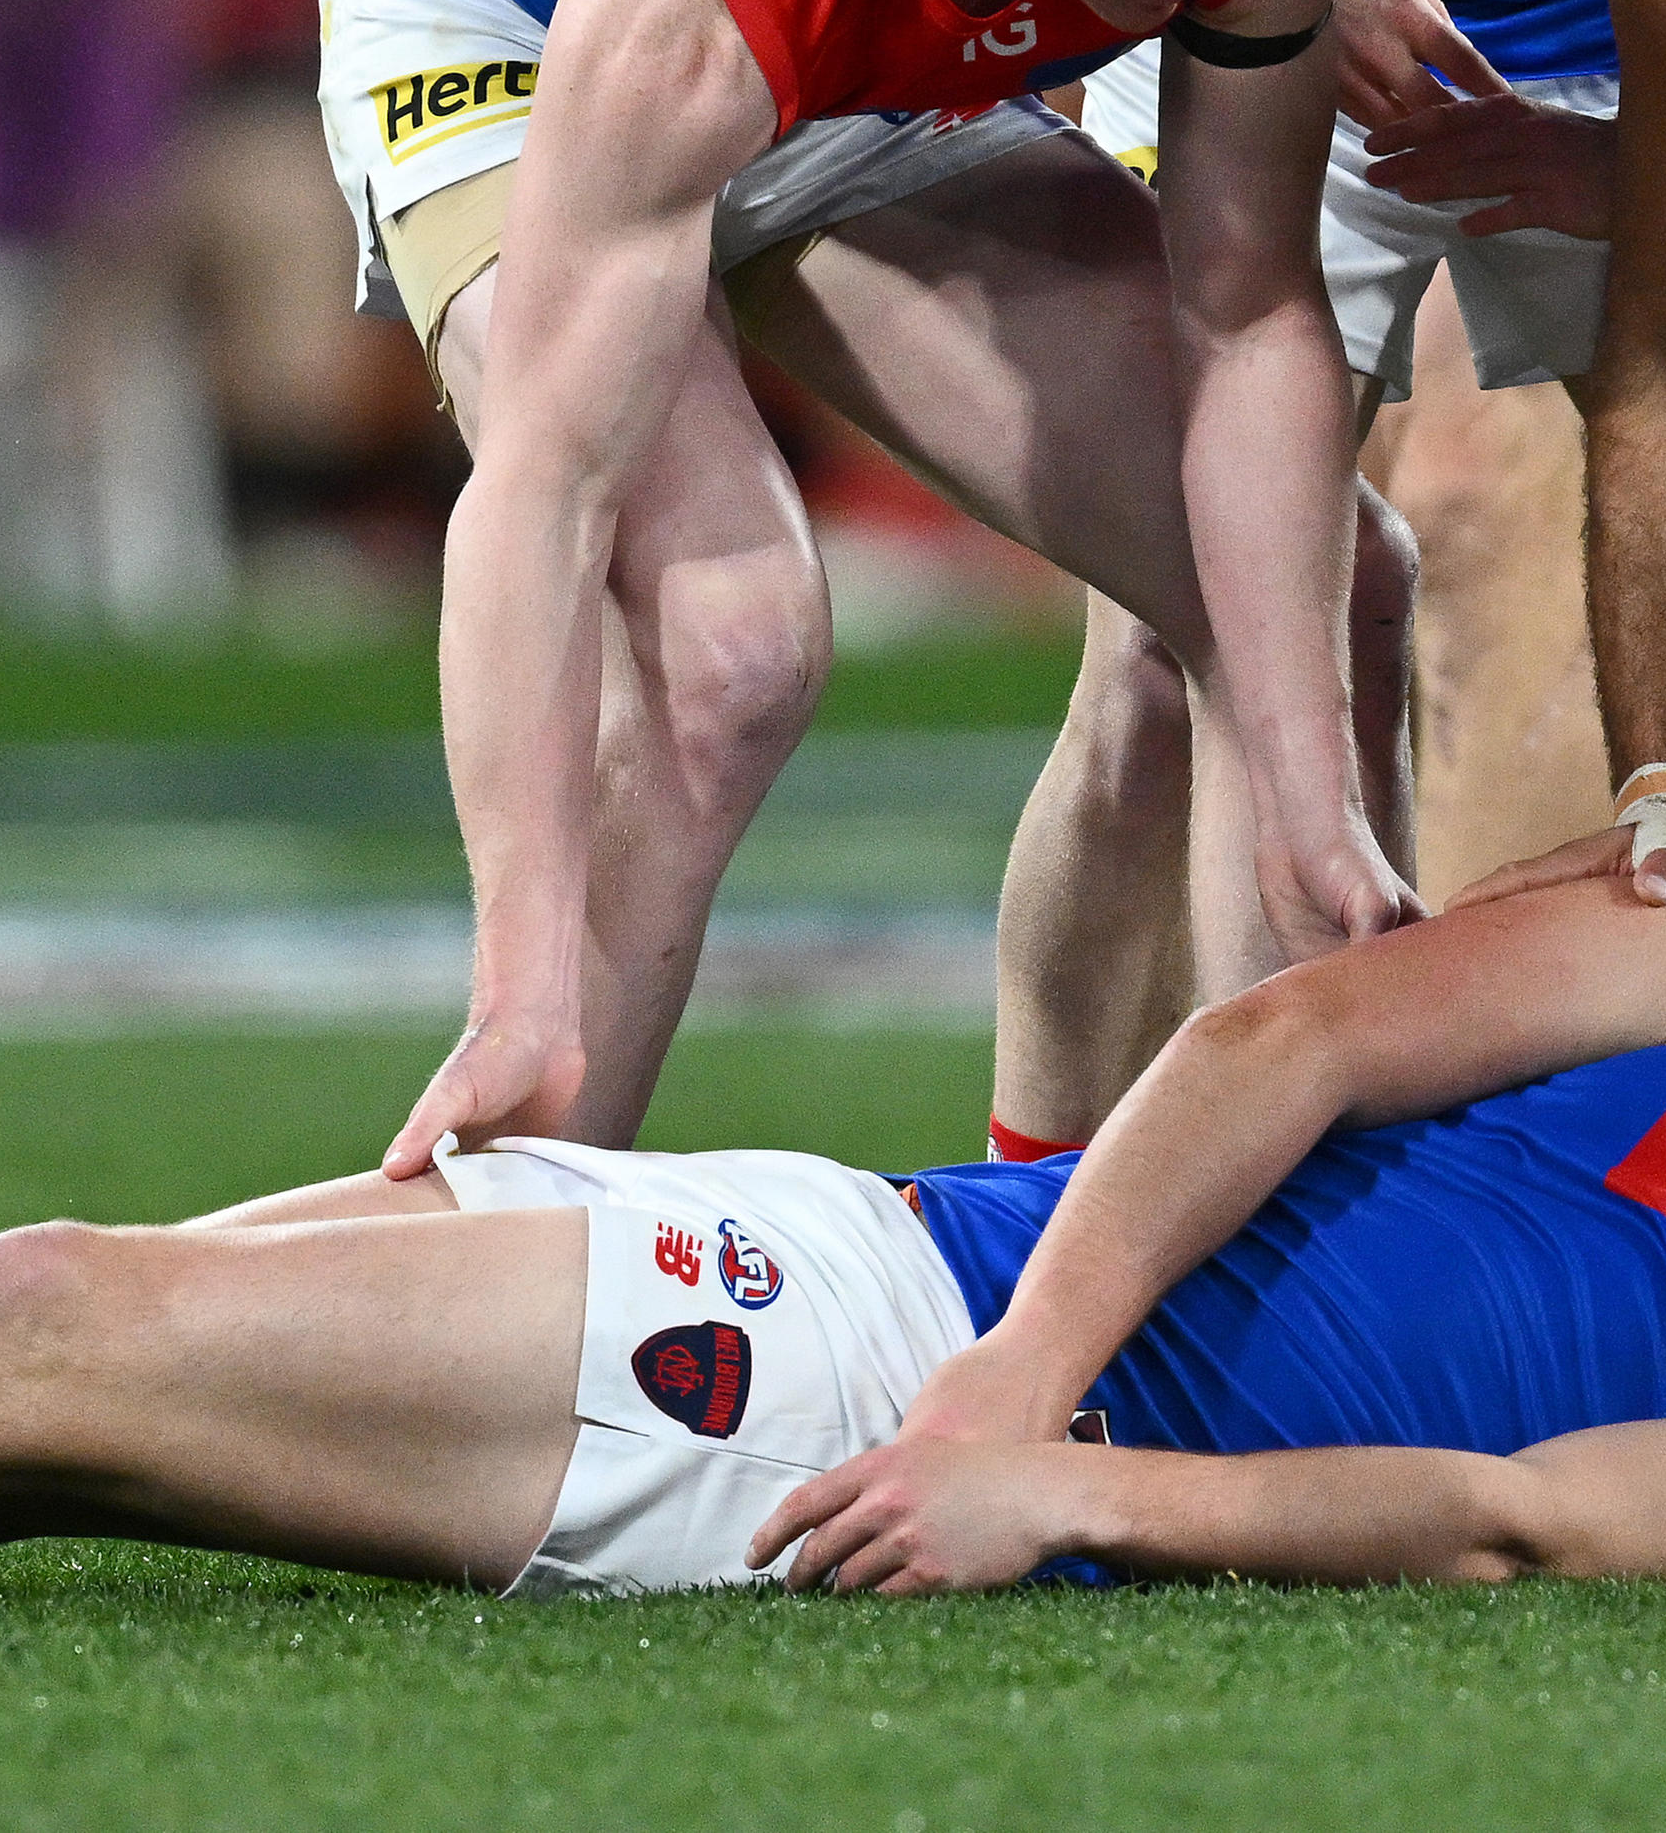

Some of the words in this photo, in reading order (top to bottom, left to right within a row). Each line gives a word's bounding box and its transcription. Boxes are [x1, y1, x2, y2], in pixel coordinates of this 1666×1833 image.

[386, 60, 540, 143] Hert
[724, 1220, 770, 1300] AFL
[700, 1326, 741, 1433] MELBOURNE
